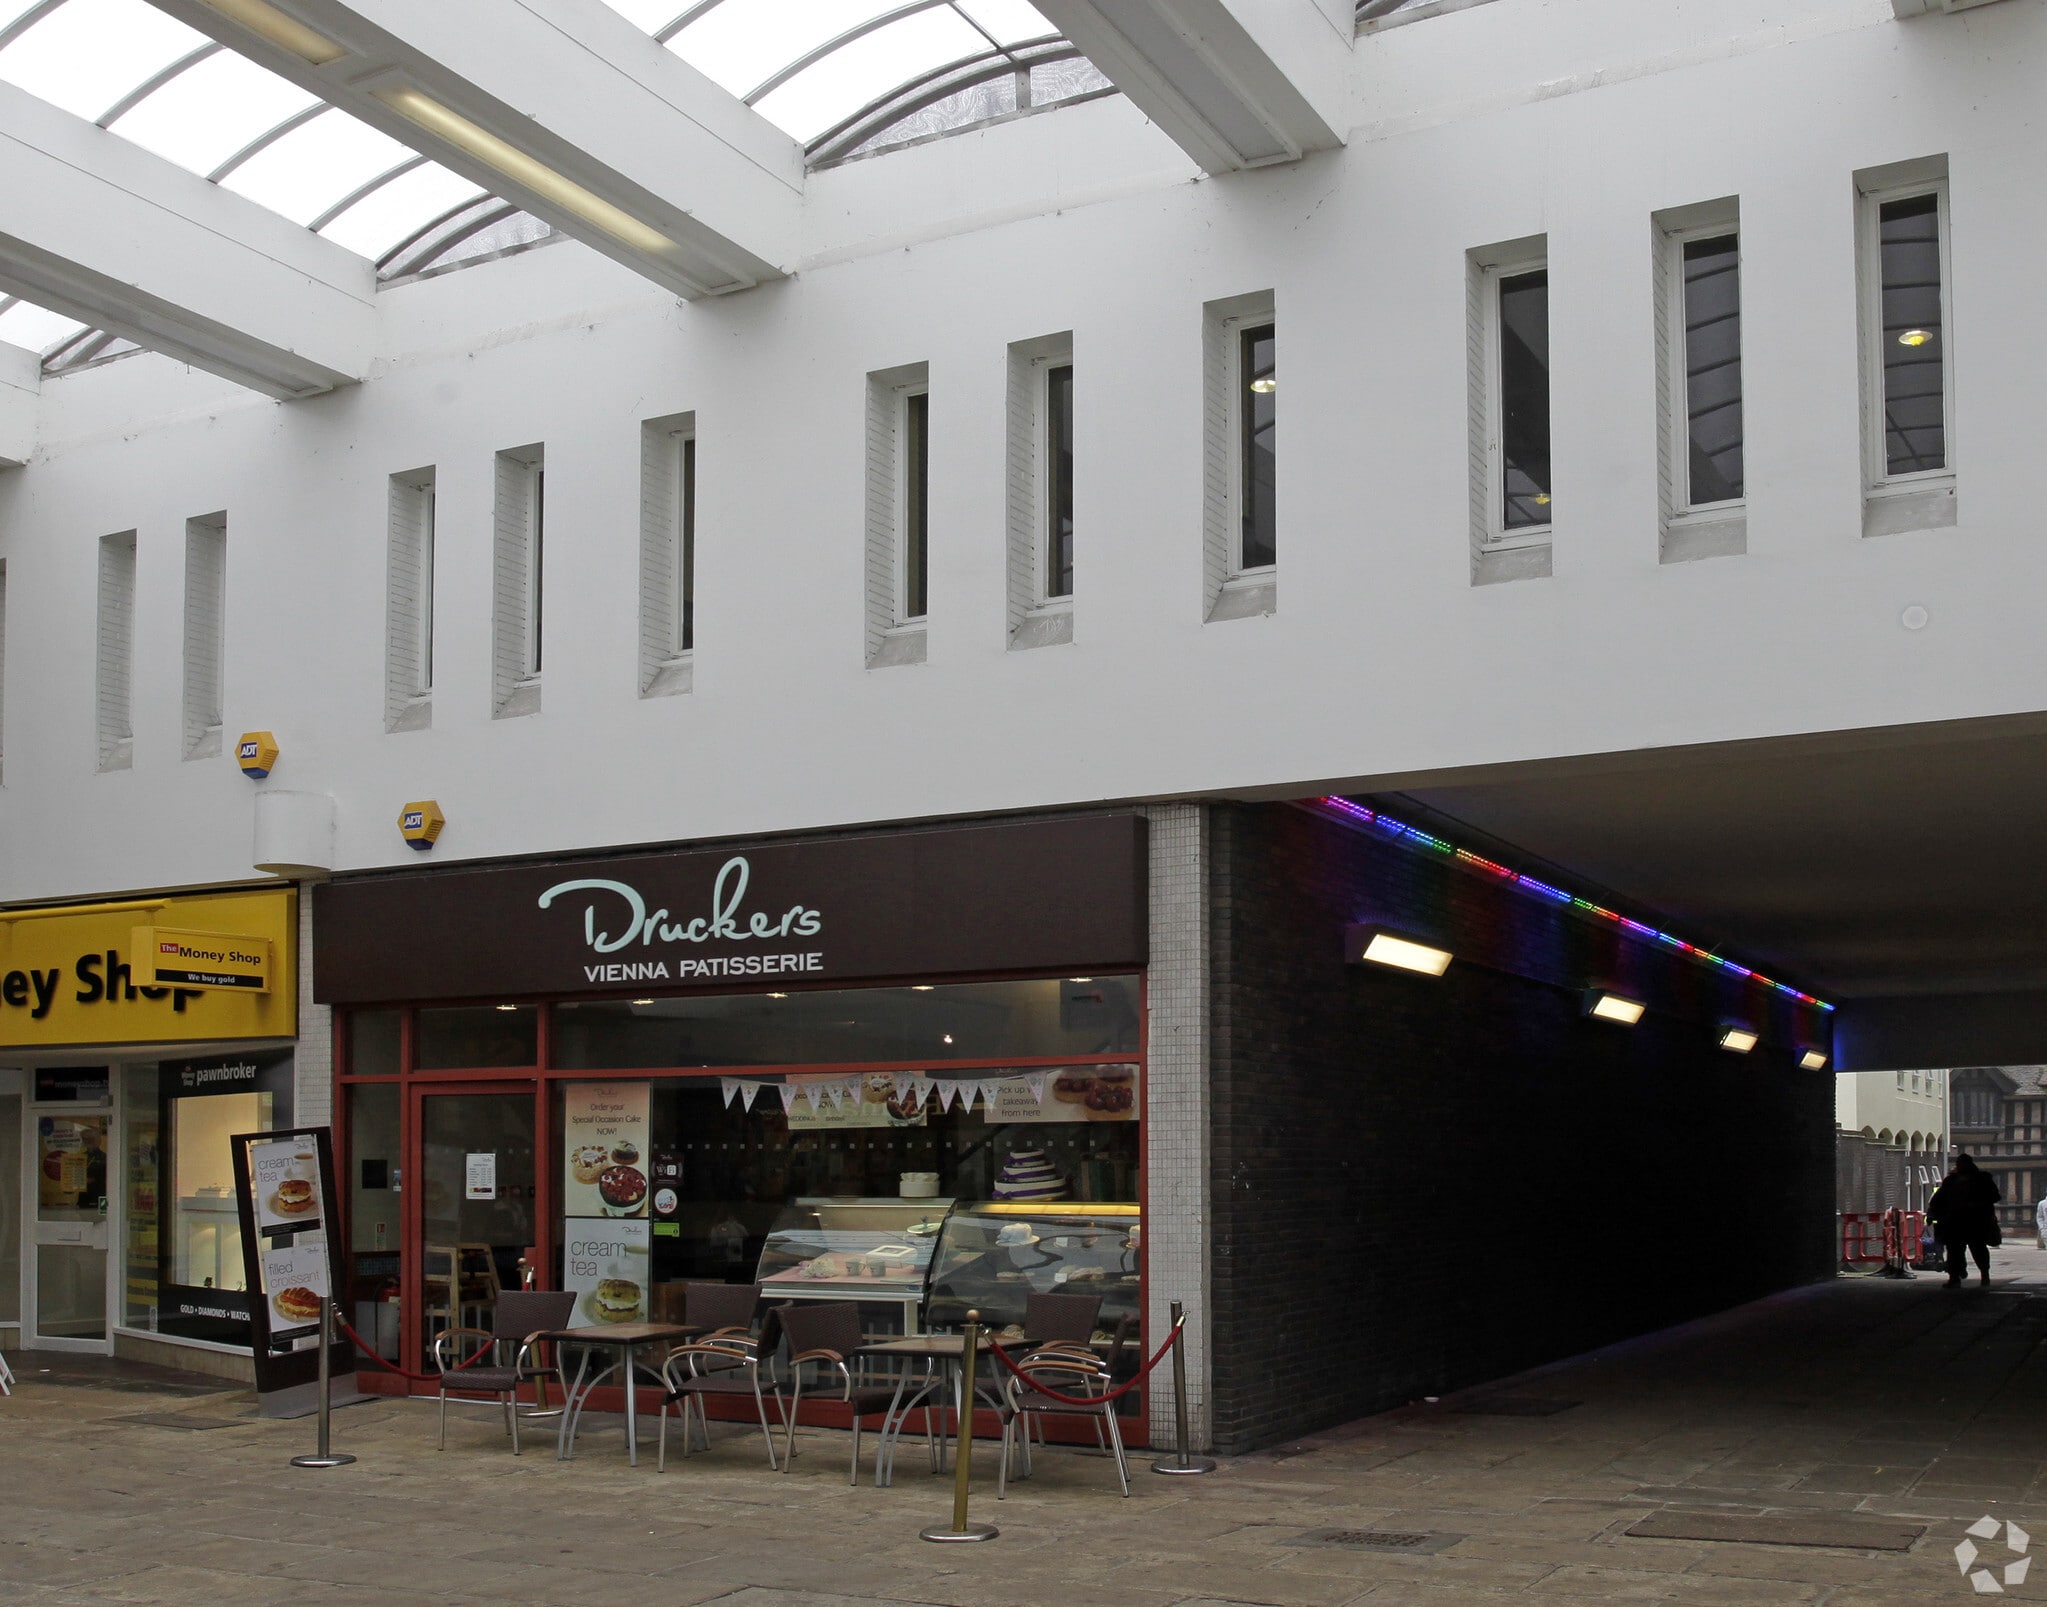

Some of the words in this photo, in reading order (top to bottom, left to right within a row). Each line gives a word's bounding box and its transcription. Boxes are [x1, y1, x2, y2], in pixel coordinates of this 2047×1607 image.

[241, 743, 257, 757] ADT
[404, 813, 422, 827] ADT
[538, 856, 821, 953] Druckers
[161, 944, 177, 952] The
[180, 947, 225, 963] Money
[229, 951, 261, 966] Shop
[584, 961, 669, 983] VIENNA
[680, 952, 823, 978] PATISSERIE
[188, 973, 200, 981] We
[202, 974, 216, 984] buy
[218, 976, 235, 984] gold
[0, 968, 60, 1019] ey
[196, 1062, 257, 1086] pawnbroker
[1014, 1087, 1025, 1095] up
[590, 1103, 608, 1111] Order
[610, 1104, 624, 1112] your
[1002, 1109, 1020, 1117] from
[1023, 1109, 1041, 1117] here
[572, 1115, 594, 1124] Special
[595, 1115, 624, 1123] Occasion
[625, 1115, 641, 1123] Cake
[596, 1127, 617, 1135] NOW!
[258, 1156, 295, 1170] cream
[259, 1171, 278, 1182] tea
[570, 1241, 627, 1257] cream
[268, 1260, 293, 1276] filled
[570, 1258, 597, 1276] tea
[270, 1270, 320, 1289] croissant
[180, 1304, 194, 1314] GOLD
[198, 1306, 226, 1318] DIAMONDS
